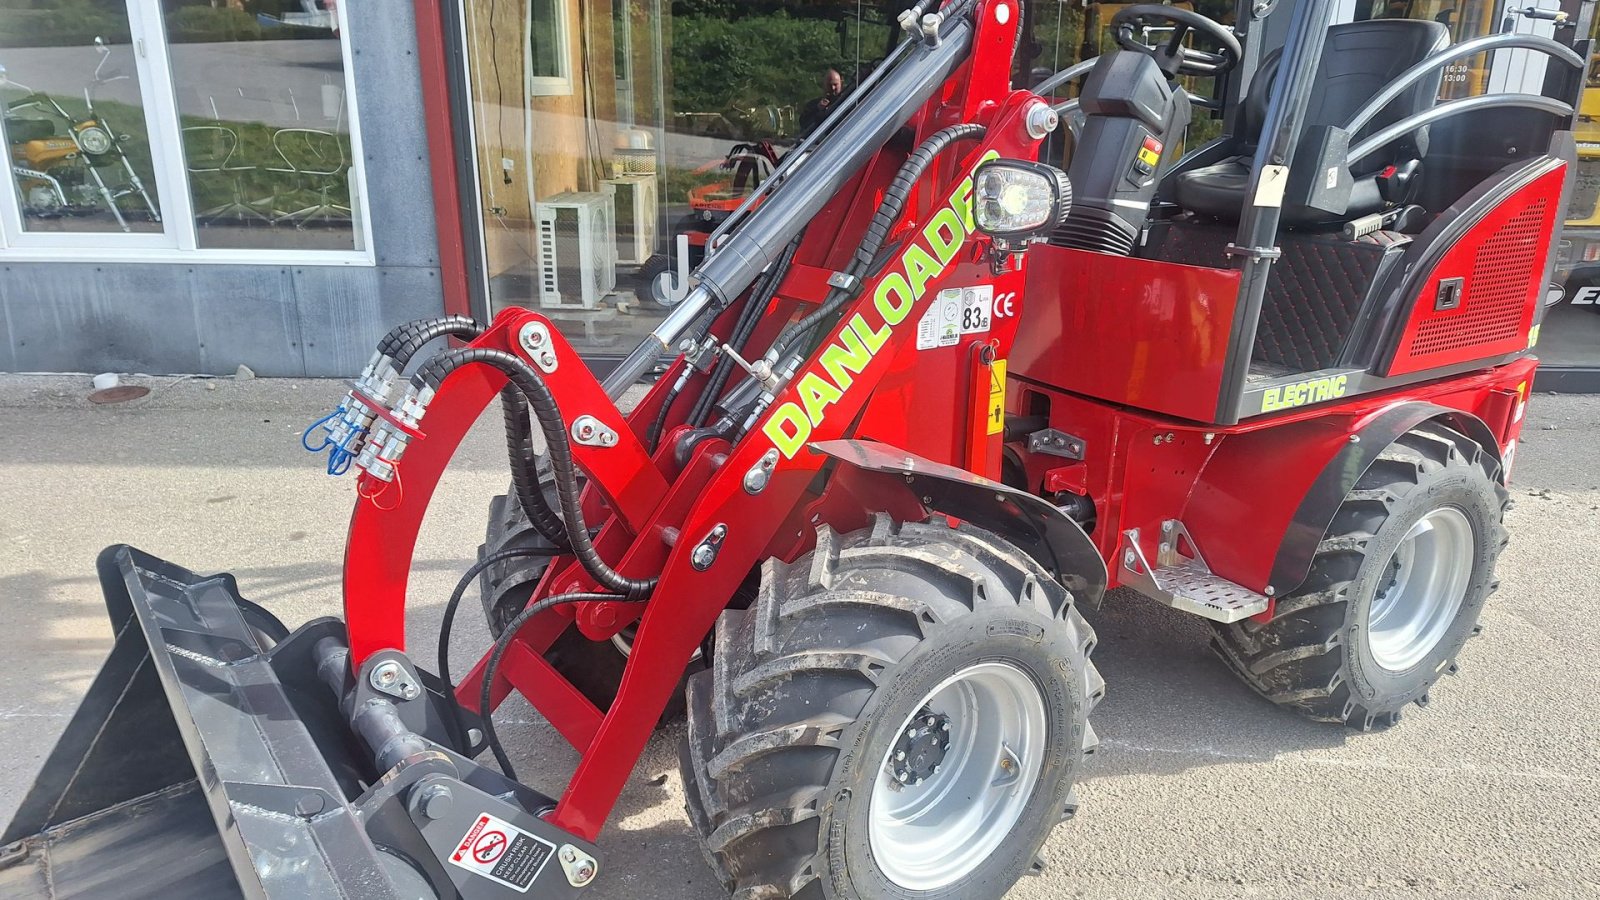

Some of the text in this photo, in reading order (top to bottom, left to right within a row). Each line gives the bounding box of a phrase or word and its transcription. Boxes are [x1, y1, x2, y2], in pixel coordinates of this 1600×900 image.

[1443, 74, 1466, 82] 13:00
[1445, 65, 1468, 73] 16:30
[762, 149, 1001, 459] DANLOADE
[993, 291, 1016, 318] CE
[1570, 286, 1600, 305] E
[962, 306, 982, 330] 83
[1261, 375, 1347, 413] ELECTRIC
[463, 820, 486, 848] DANGER
[495, 836, 527, 876] CRUSH RISK
[502, 845, 529, 879] KEEP CLEAR
